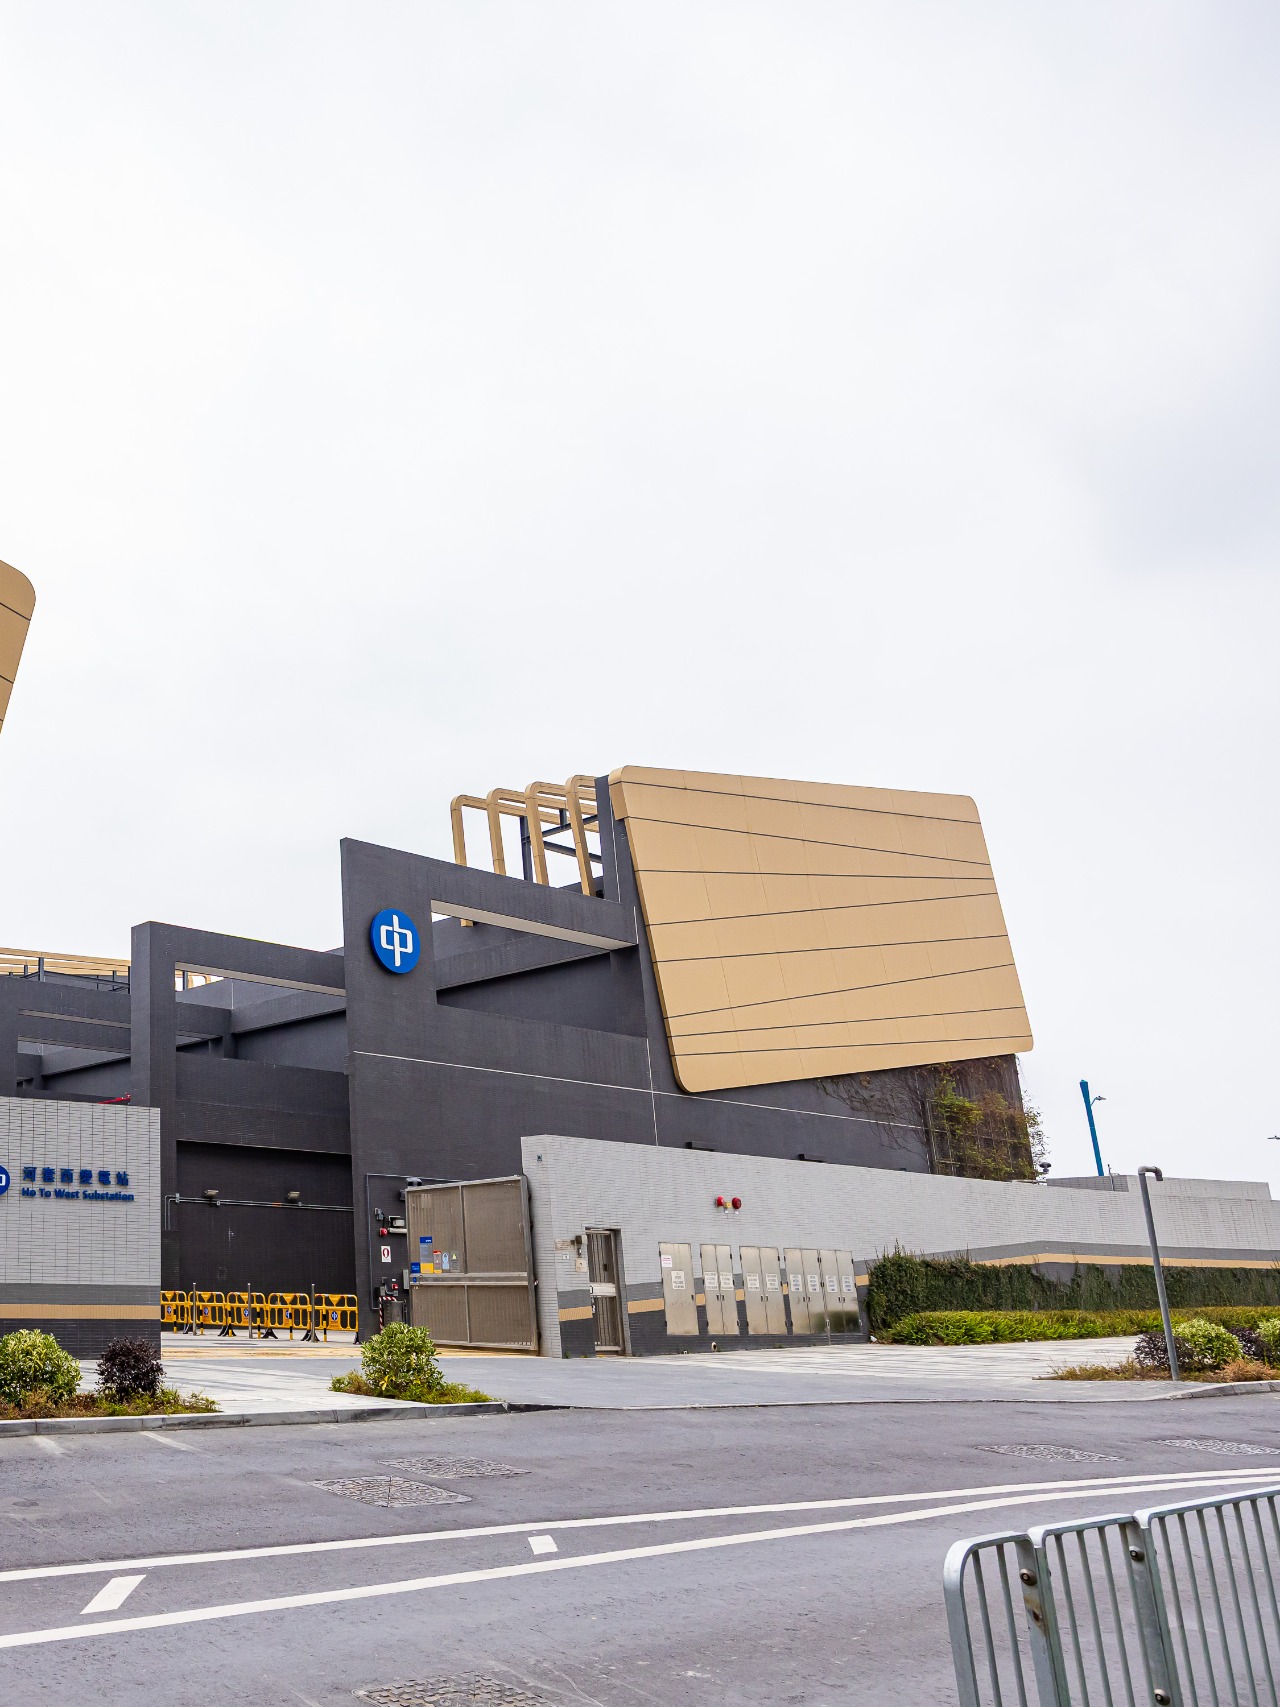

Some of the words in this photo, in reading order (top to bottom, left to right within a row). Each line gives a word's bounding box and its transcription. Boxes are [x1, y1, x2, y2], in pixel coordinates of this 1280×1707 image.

[23, 1166, 129, 1187] 河套西變電站
[22, 1187, 37, 1198] Ho
[38, 1188, 52, 1199] To
[54, 1188, 80, 1200] West
[83, 1189, 135, 1202] Substation
